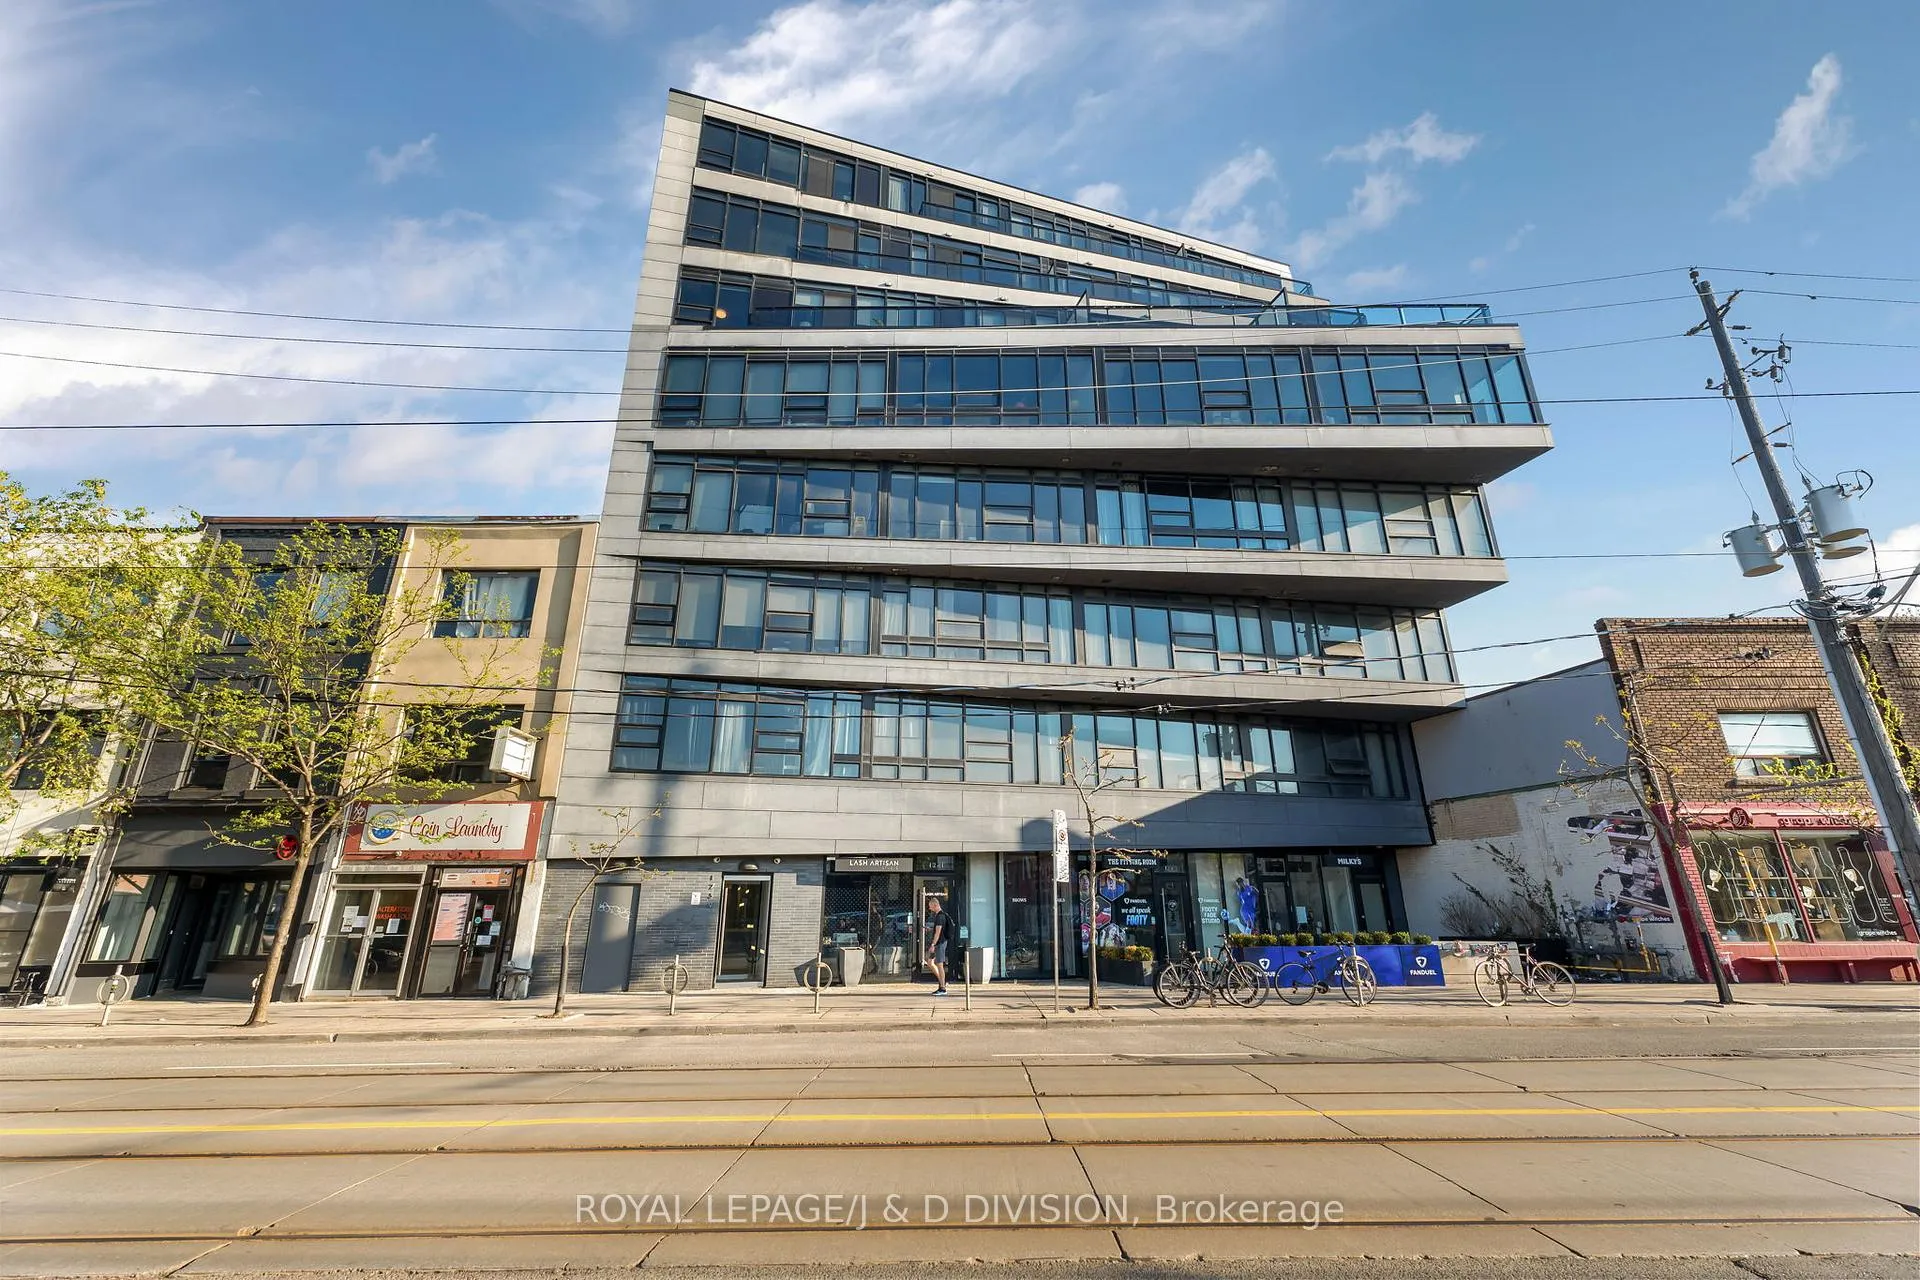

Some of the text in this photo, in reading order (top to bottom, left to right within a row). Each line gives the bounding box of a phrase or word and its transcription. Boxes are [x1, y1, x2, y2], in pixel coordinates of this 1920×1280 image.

[409, 815, 503, 843] Coin Laundry
[1142, 858, 1157, 866] ROOM
[1337, 856, 1362, 865] MILKY'S
[1126, 915, 1148, 925] FOOTY
